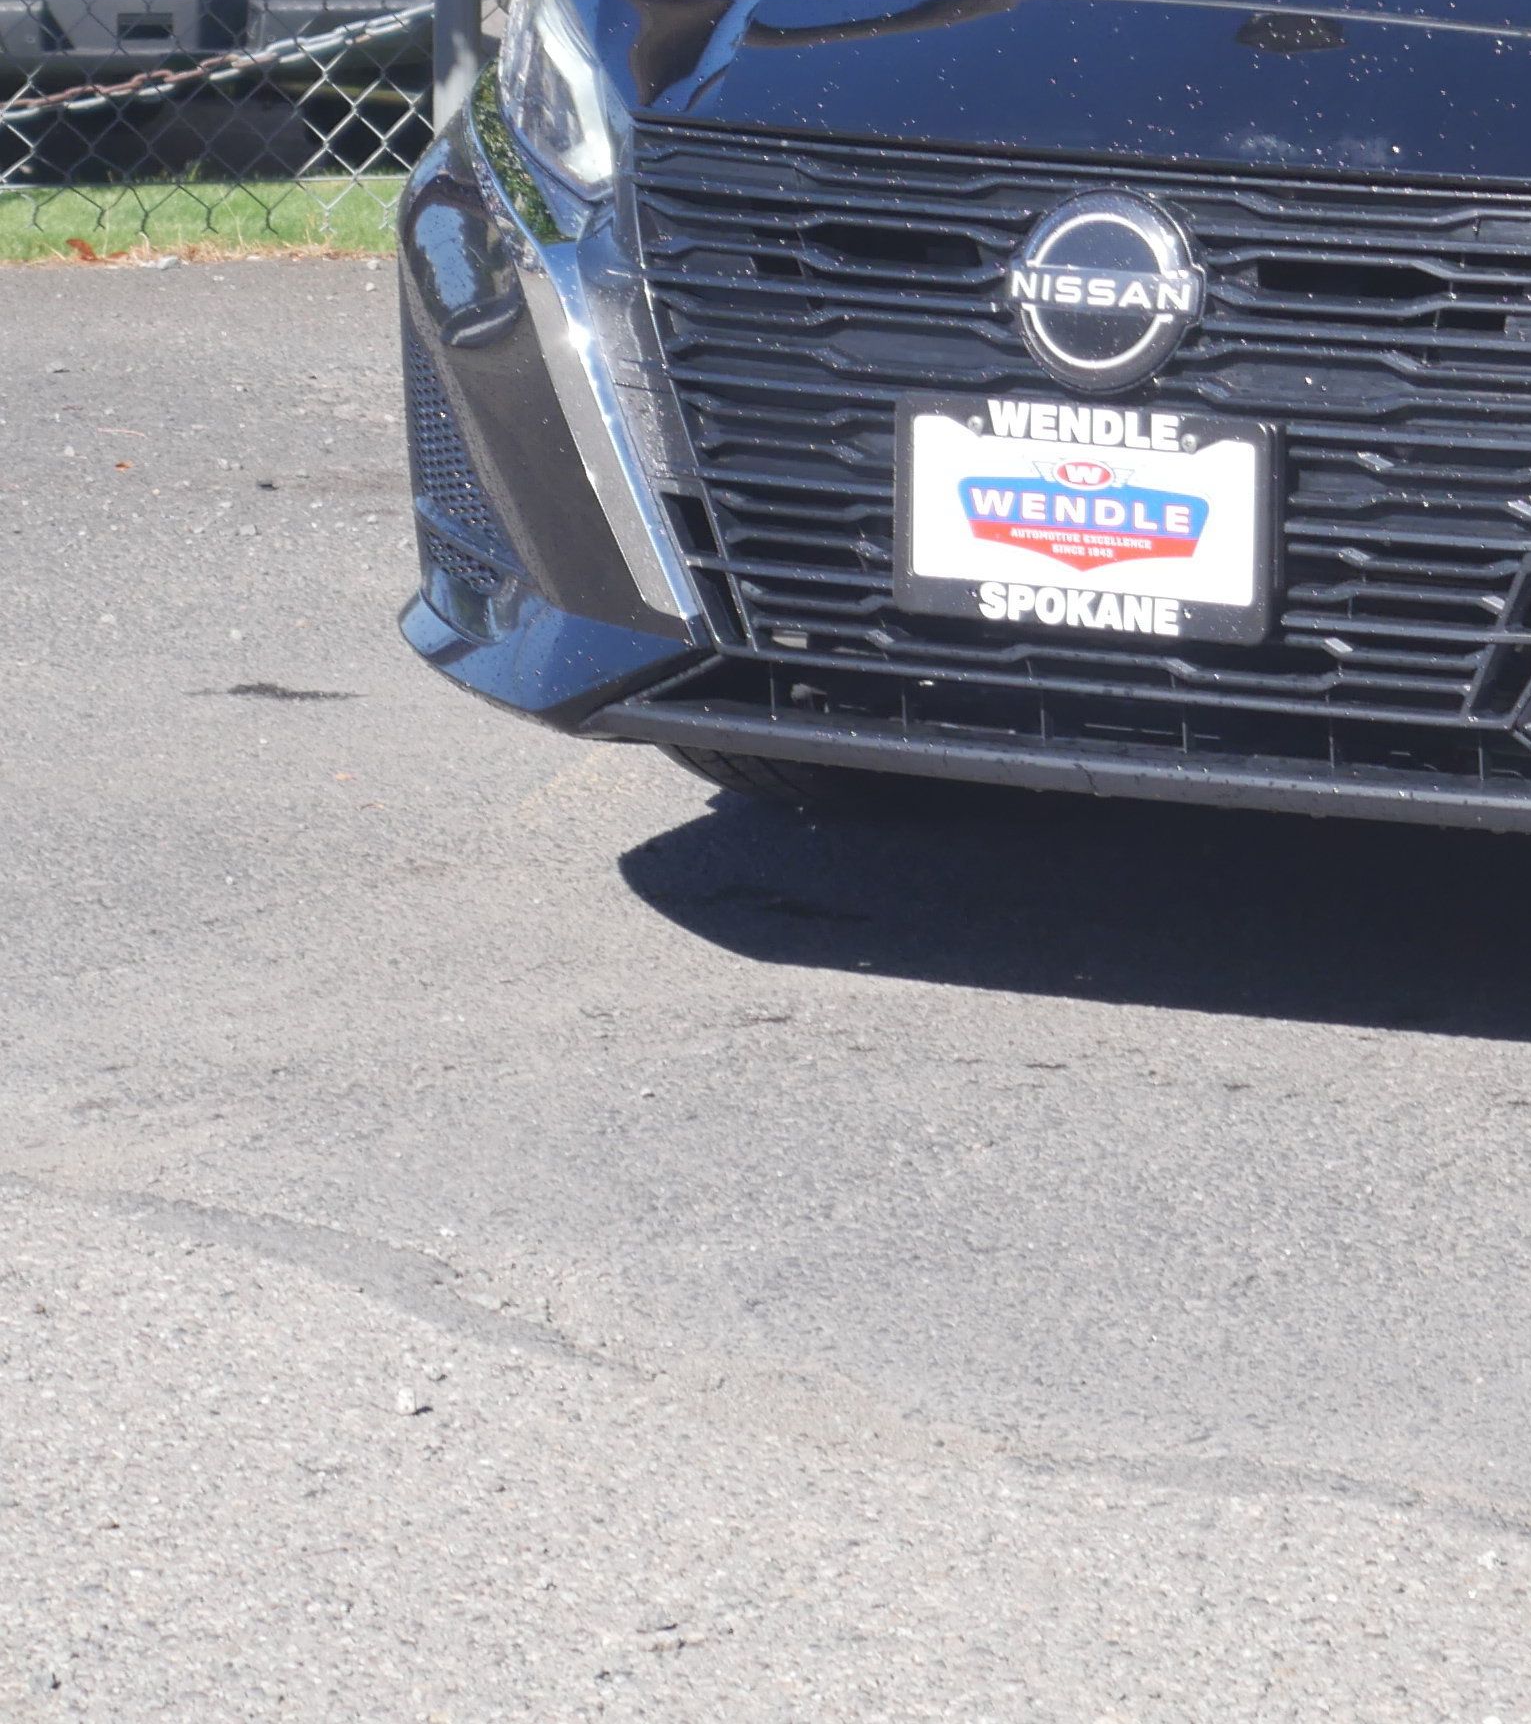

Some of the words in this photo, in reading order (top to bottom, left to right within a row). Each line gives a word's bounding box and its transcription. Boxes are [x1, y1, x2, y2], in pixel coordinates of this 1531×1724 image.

[1010, 270, 1192, 312] NISSAN
[987, 399, 1182, 452] WENDLE
[971, 487, 1191, 534] WENDLE
[1010, 527, 1081, 543] AUTOMOTIVE
[1082, 532, 1153, 551] EXCELLENCE
[1051, 543, 1086, 557] SINCE
[978, 581, 1182, 636] SPOKANE
